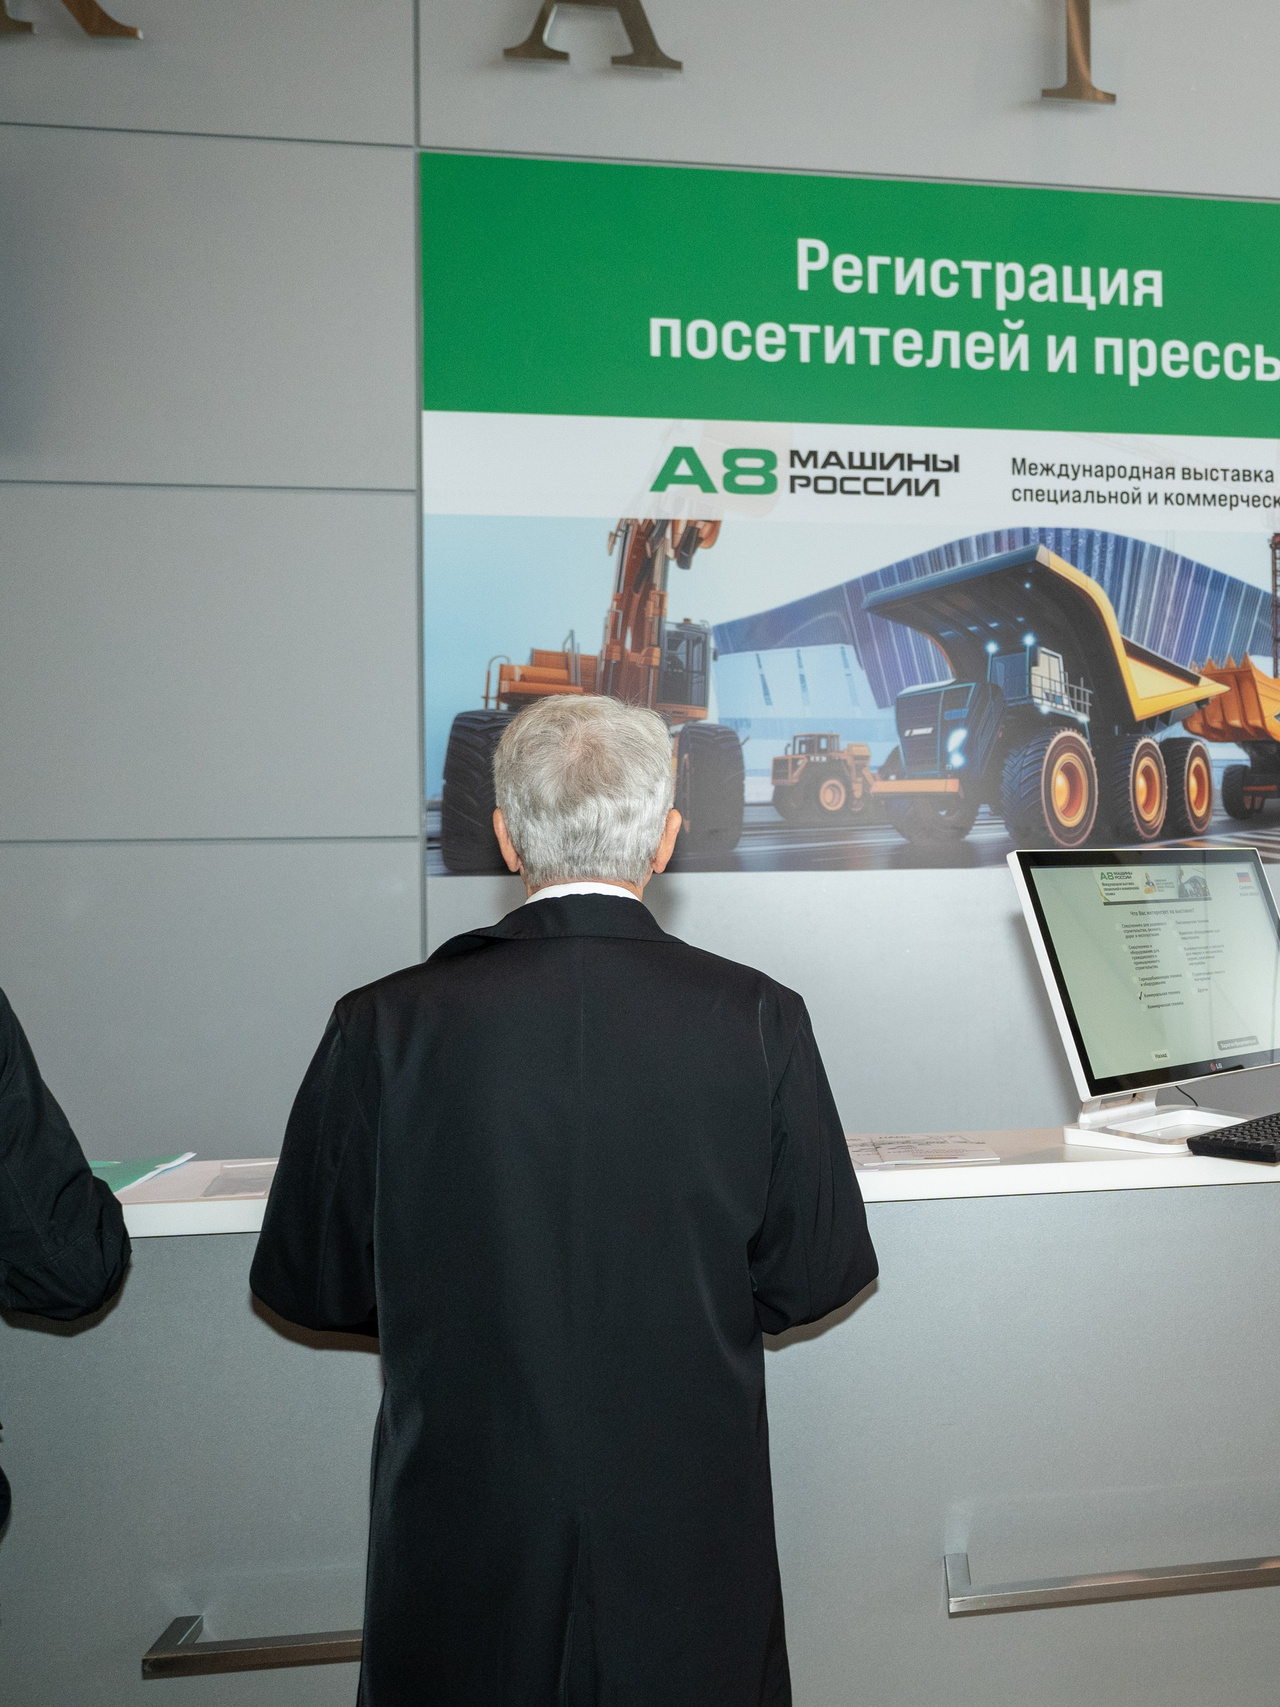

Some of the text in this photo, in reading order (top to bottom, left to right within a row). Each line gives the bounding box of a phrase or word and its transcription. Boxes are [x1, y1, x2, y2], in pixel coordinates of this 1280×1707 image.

[797, 237, 1164, 311] Регистрация
[649, 317, 1030, 372] посетителей
[1047, 333, 1077, 374] и
[789, 449, 960, 474] МАШИНЫ
[1011, 457, 1275, 484] Международная выставка
[789, 475, 941, 498] РОССИИ
[1011, 485, 1142, 506] специальной
[1147, 491, 1159, 506] и
[1215, 1062, 1223, 1070] LG
